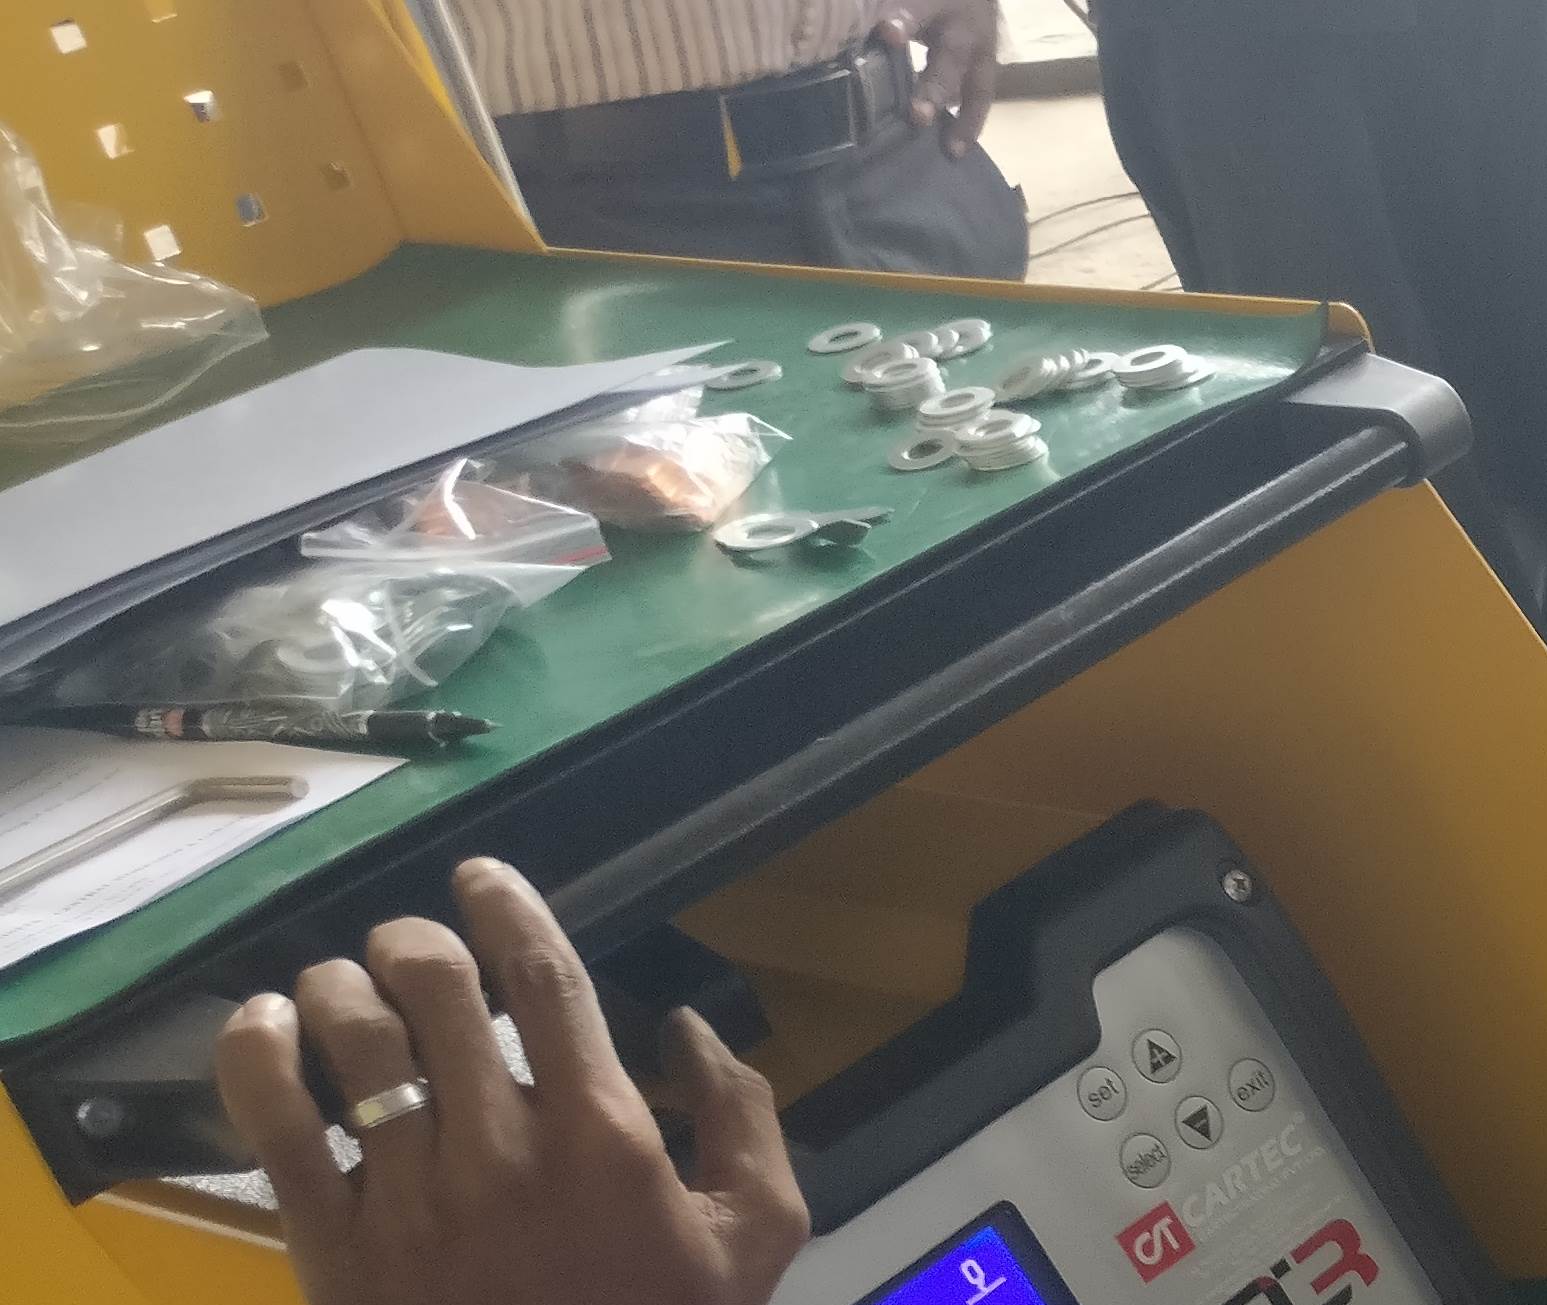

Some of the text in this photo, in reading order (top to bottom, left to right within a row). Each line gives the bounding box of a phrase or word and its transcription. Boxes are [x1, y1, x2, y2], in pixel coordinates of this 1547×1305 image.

[1087, 1077, 1120, 1109] set
[1236, 1070, 1271, 1103] exit
[1126, 1142, 1169, 1181] select
